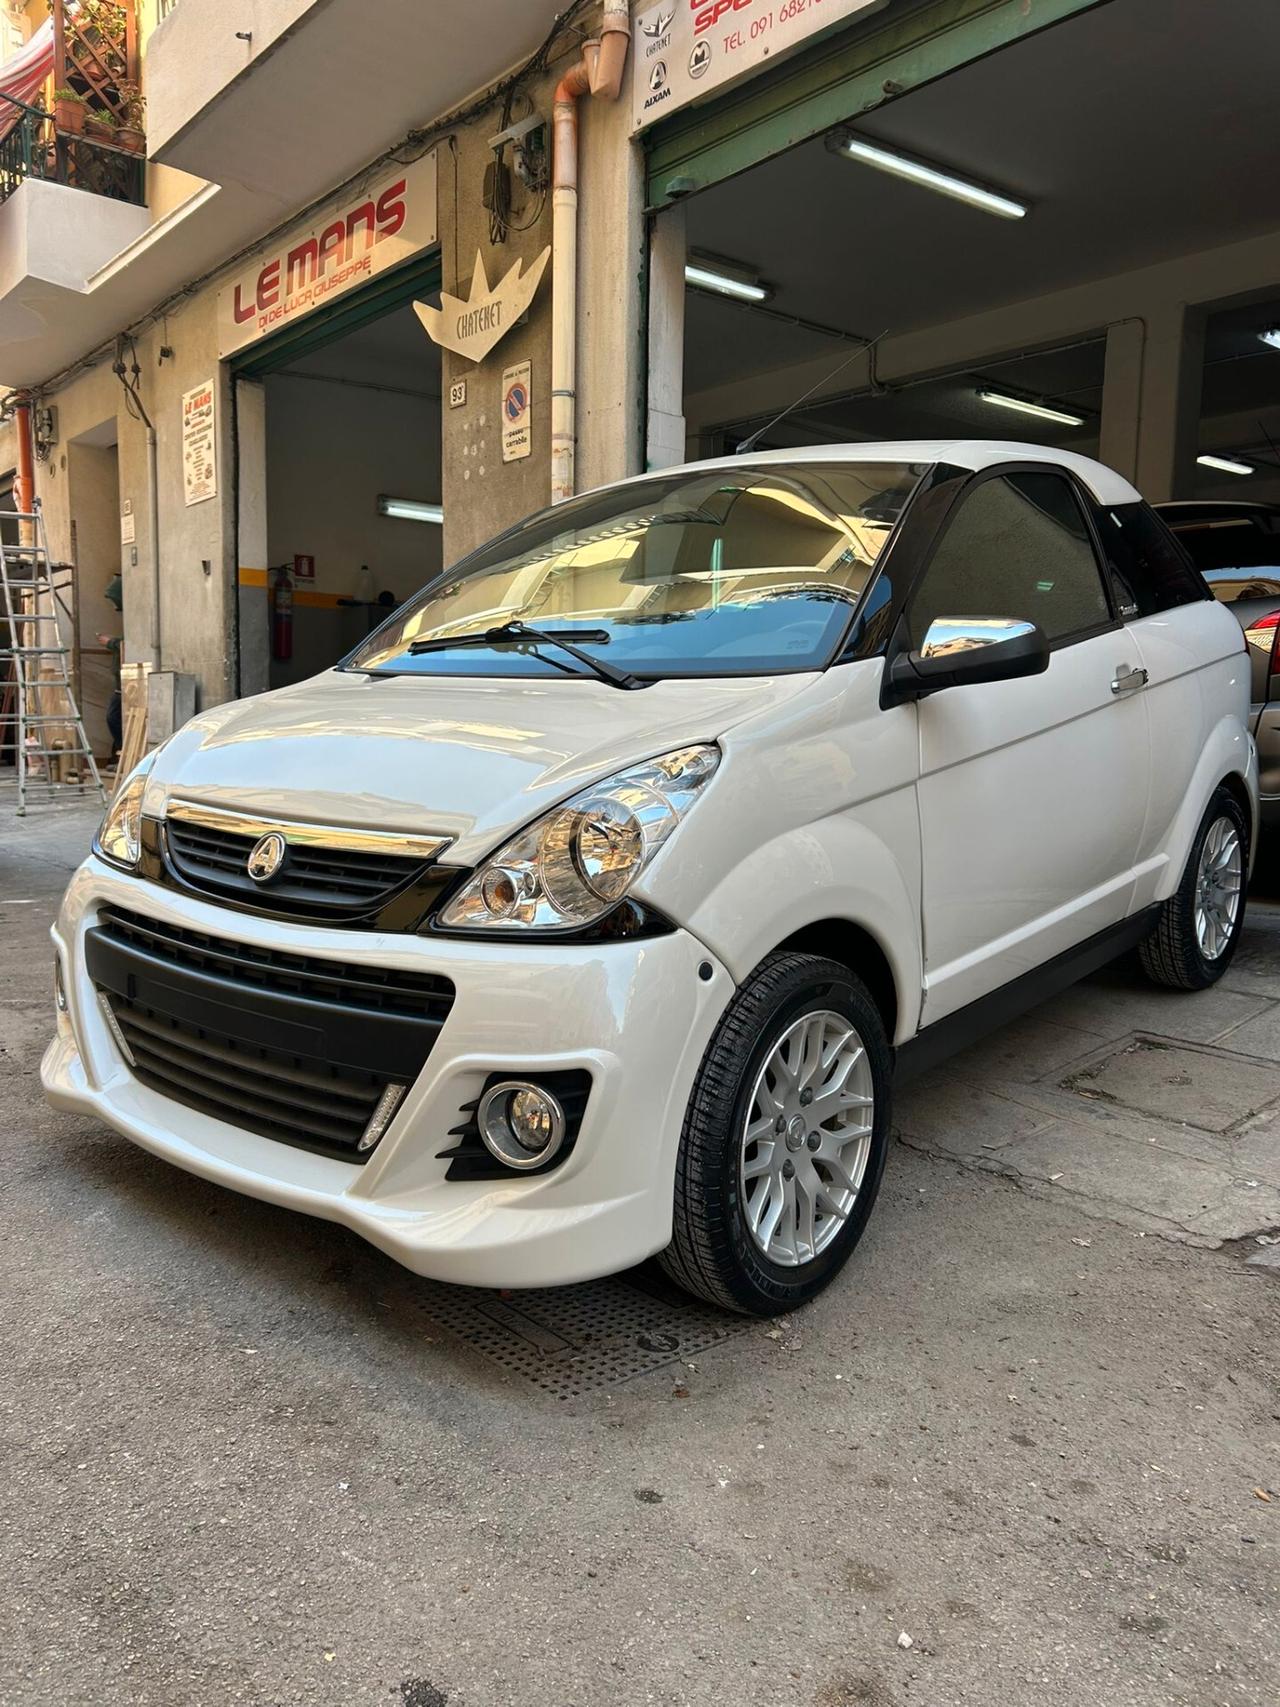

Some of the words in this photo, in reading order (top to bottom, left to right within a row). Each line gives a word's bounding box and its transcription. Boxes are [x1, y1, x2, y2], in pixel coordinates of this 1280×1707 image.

[723, 30, 746, 54] TEL.
[750, 12, 773, 39] 091
[644, 88, 671, 110] AIXAM
[234, 259, 281, 325] LE
[259, 316, 268, 329] DI
[268, 308, 283, 323] DE
[284, 289, 312, 315] LUCA
[313, 255, 372, 298] GIUSEPPE
[456, 300, 503, 340] CHATENET
[452, 387, 463, 402] 93
